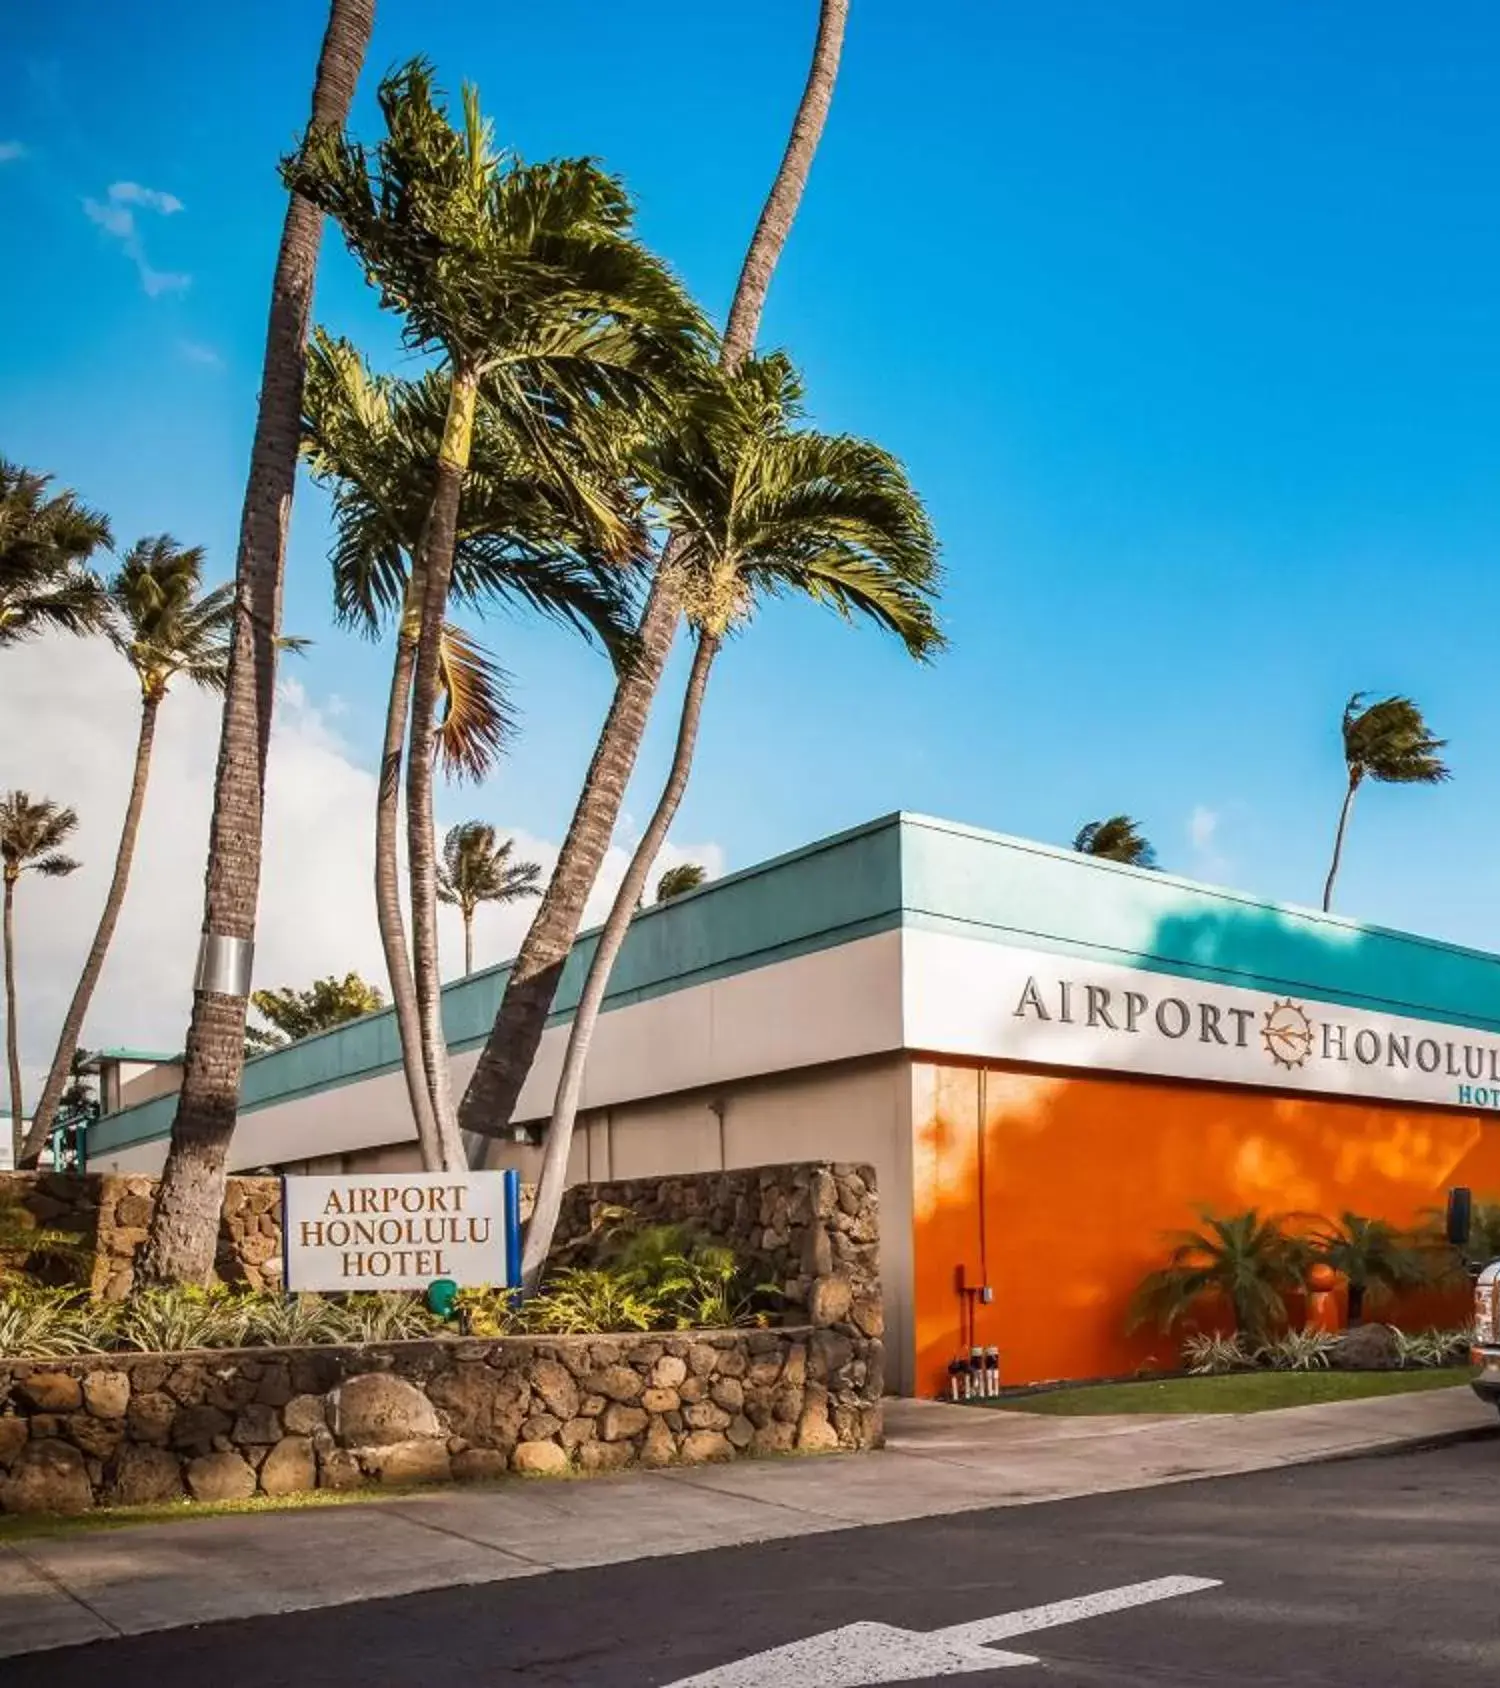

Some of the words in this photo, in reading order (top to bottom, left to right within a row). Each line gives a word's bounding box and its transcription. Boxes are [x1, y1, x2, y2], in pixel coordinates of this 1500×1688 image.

[1012, 975, 1255, 1047] AIRPORT
[323, 1185, 467, 1215] AIRPORT
[300, 1217, 492, 1247] HONOLULU
[342, 1249, 450, 1277] HOTEL
